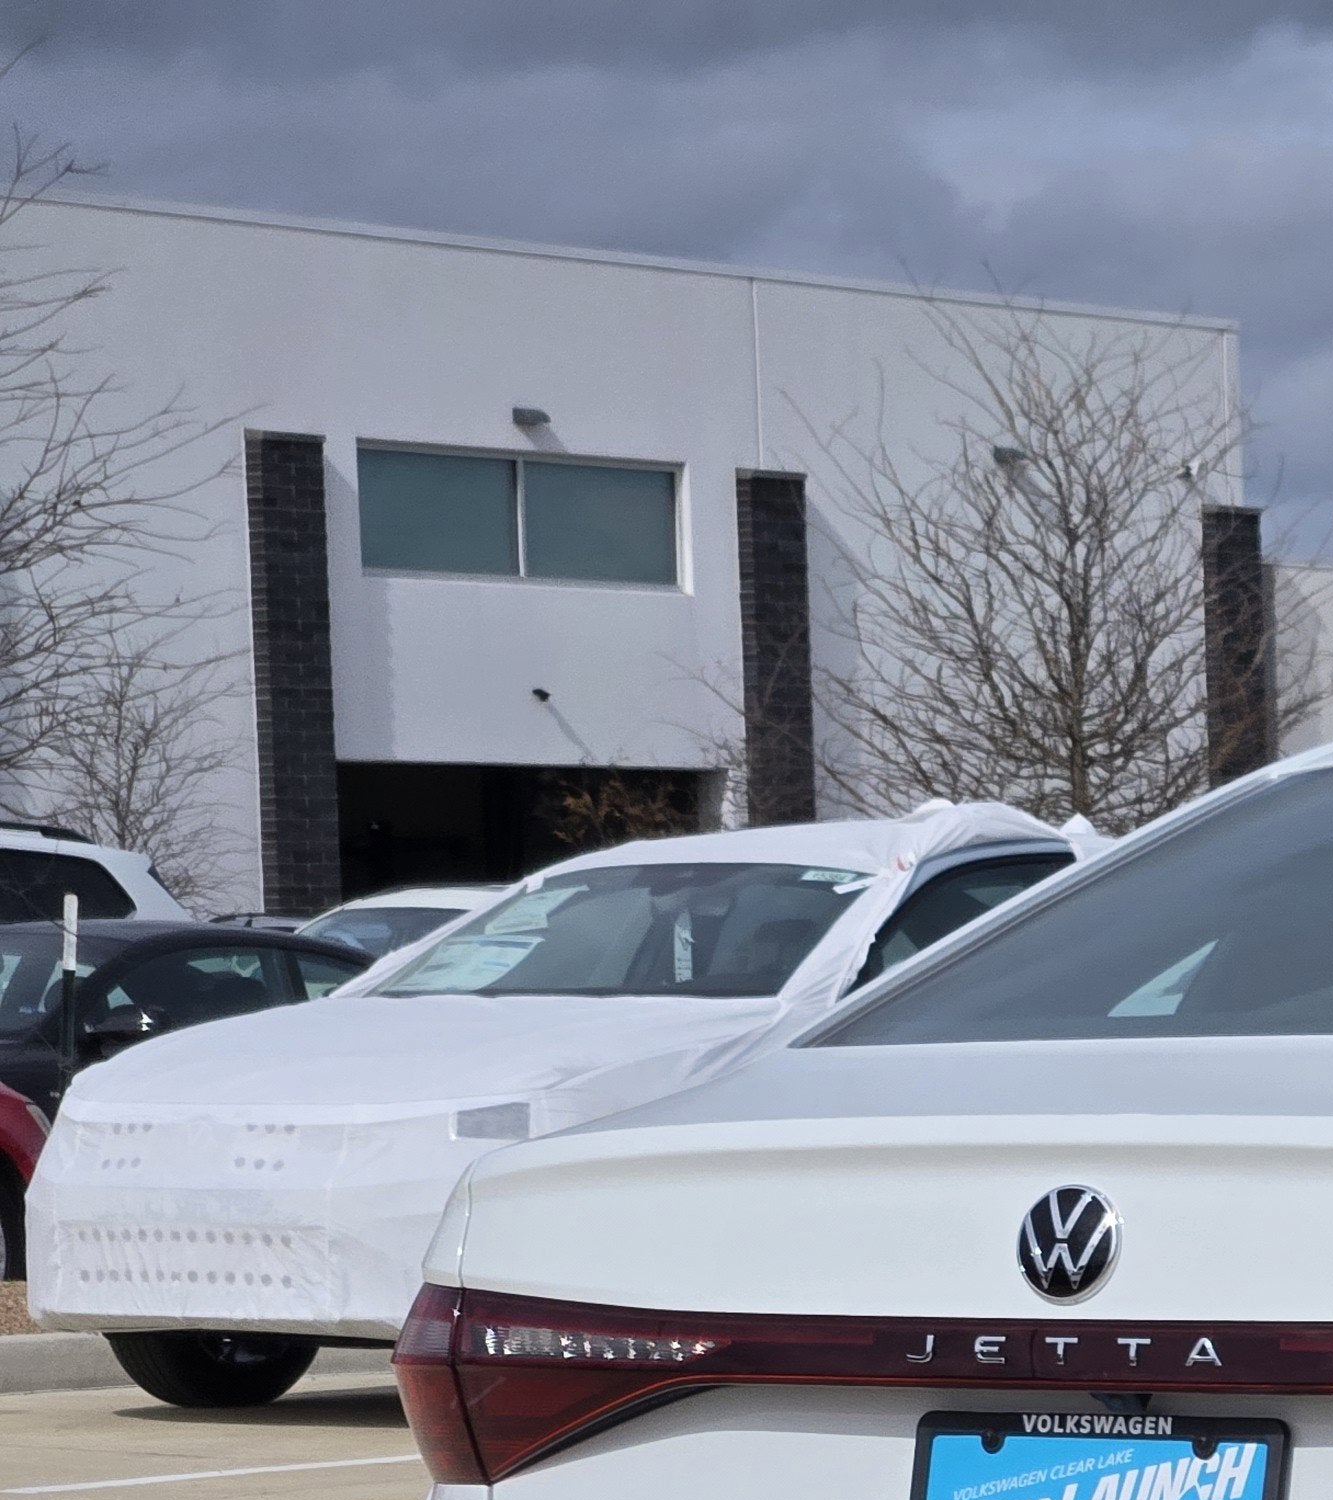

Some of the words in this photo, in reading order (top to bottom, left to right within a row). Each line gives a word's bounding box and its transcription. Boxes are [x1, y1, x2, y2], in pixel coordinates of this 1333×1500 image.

[906, 1334, 1223, 1367] JETTA
[1023, 1415, 1173, 1435] VOLKSWAGEN
[1050, 1457, 1096, 1480] CLEAR
[1097, 1448, 1135, 1469] LAKE
